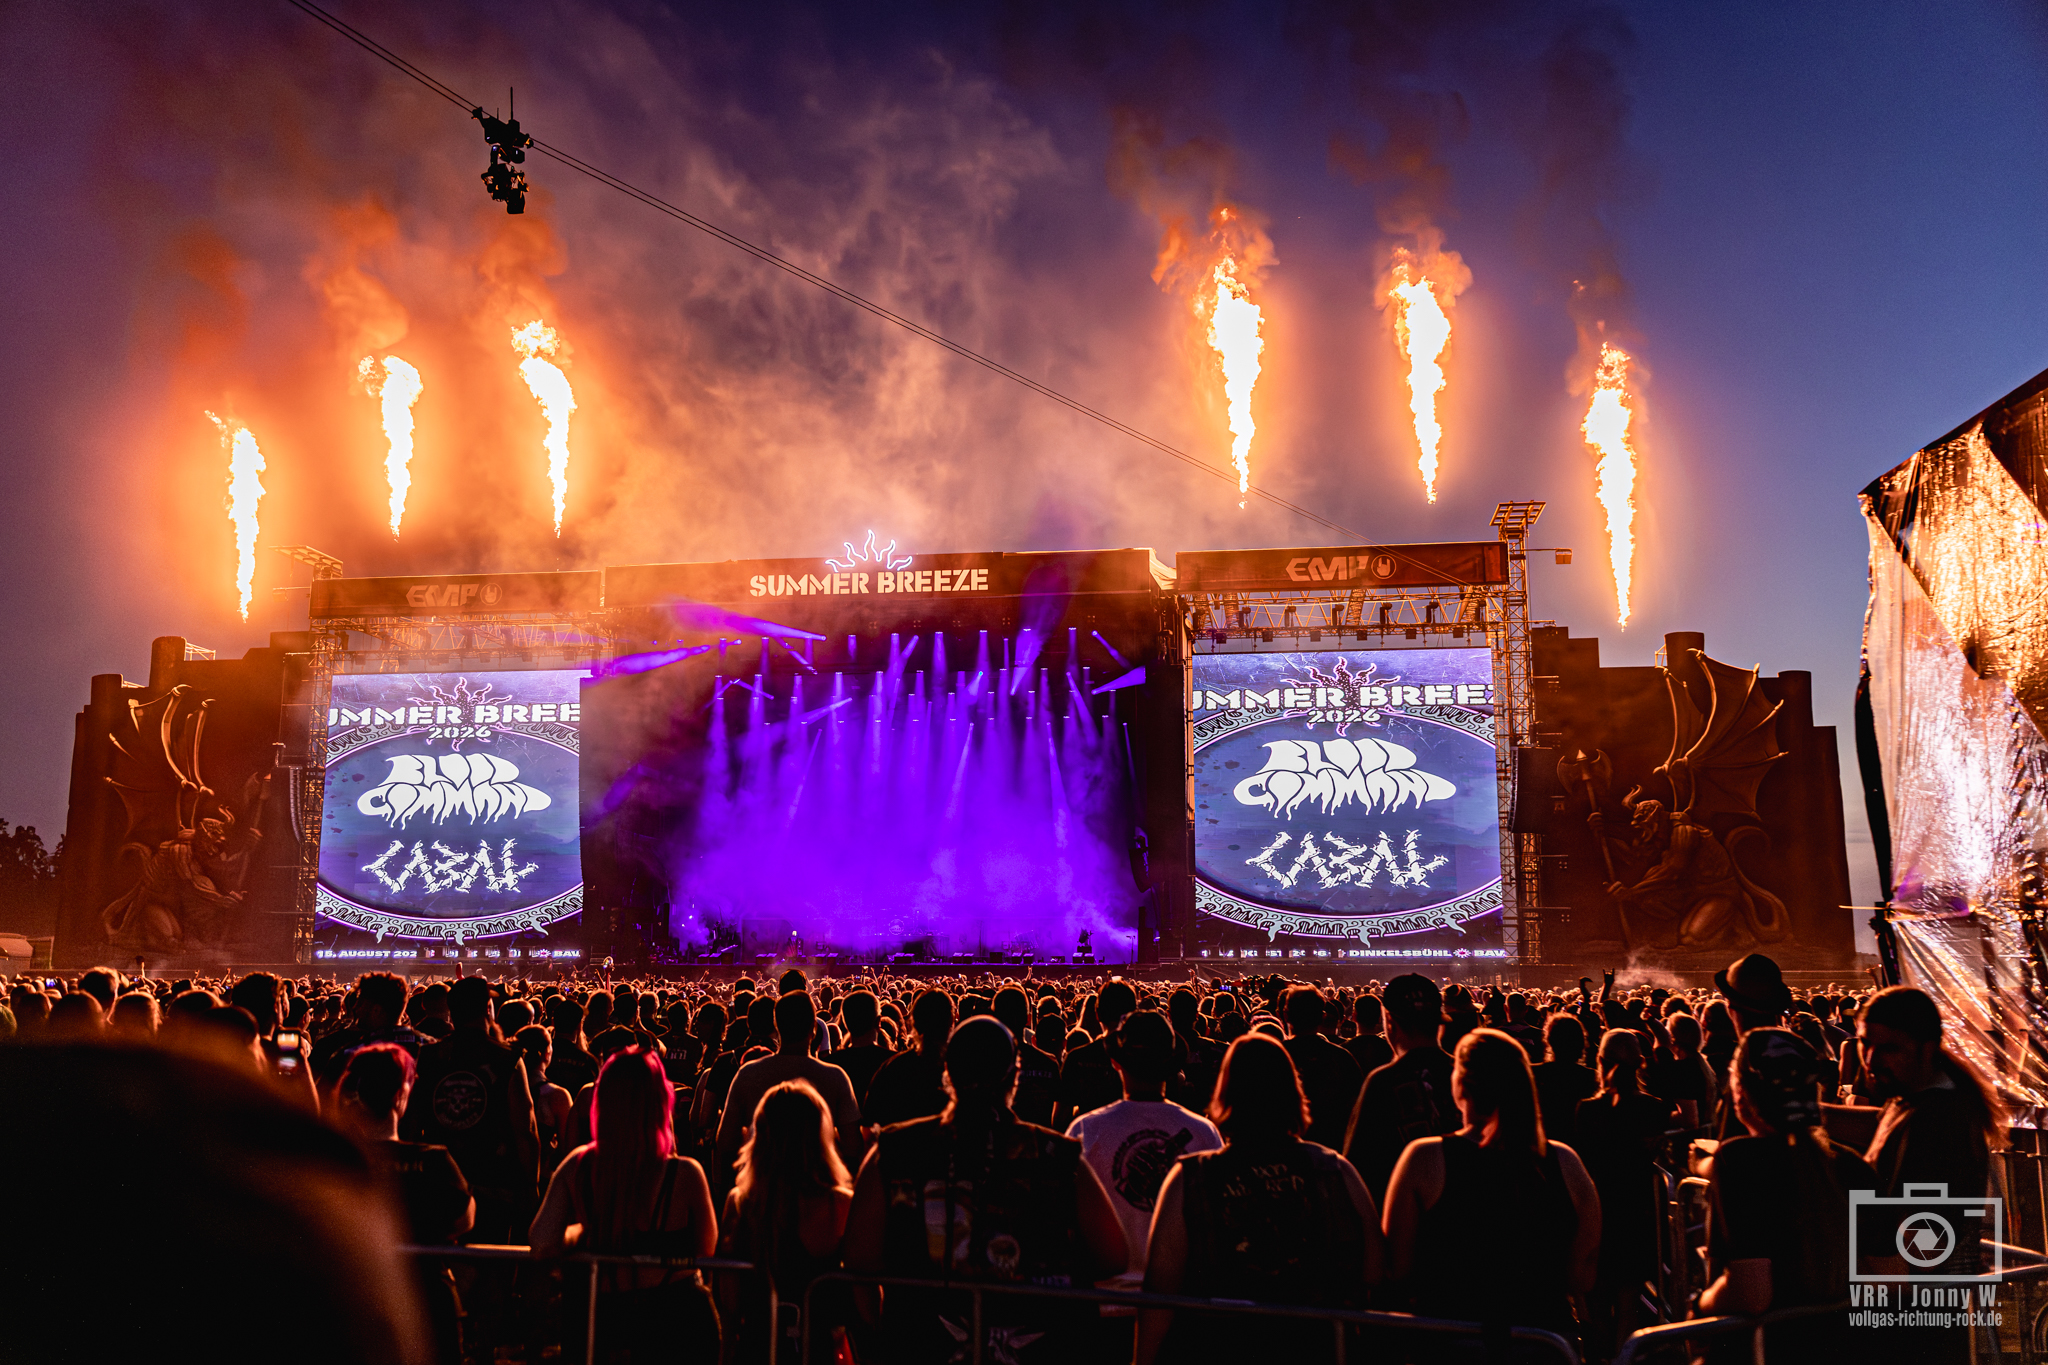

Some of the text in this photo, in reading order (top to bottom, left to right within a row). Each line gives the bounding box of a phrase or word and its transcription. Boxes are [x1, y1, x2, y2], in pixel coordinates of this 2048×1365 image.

[1285, 556, 1369, 581] EMP
[750, 568, 989, 597] SUMMER BREEZE
[406, 584, 479, 607] EMP
[1360, 684, 1495, 707] BREE
[1308, 709, 1380, 723] 2026
[428, 725, 492, 739] 2026
[1255, 738, 1417, 777] BLOOD
[378, 753, 519, 791] BLOOD
[357, 782, 551, 830] COMMAND
[1233, 769, 1457, 821] COMMAND
[338, 950, 391, 958] AUGUST
[393, 950, 418, 958] 202
[1349, 948, 1452, 957] DINKELSBÜHL
